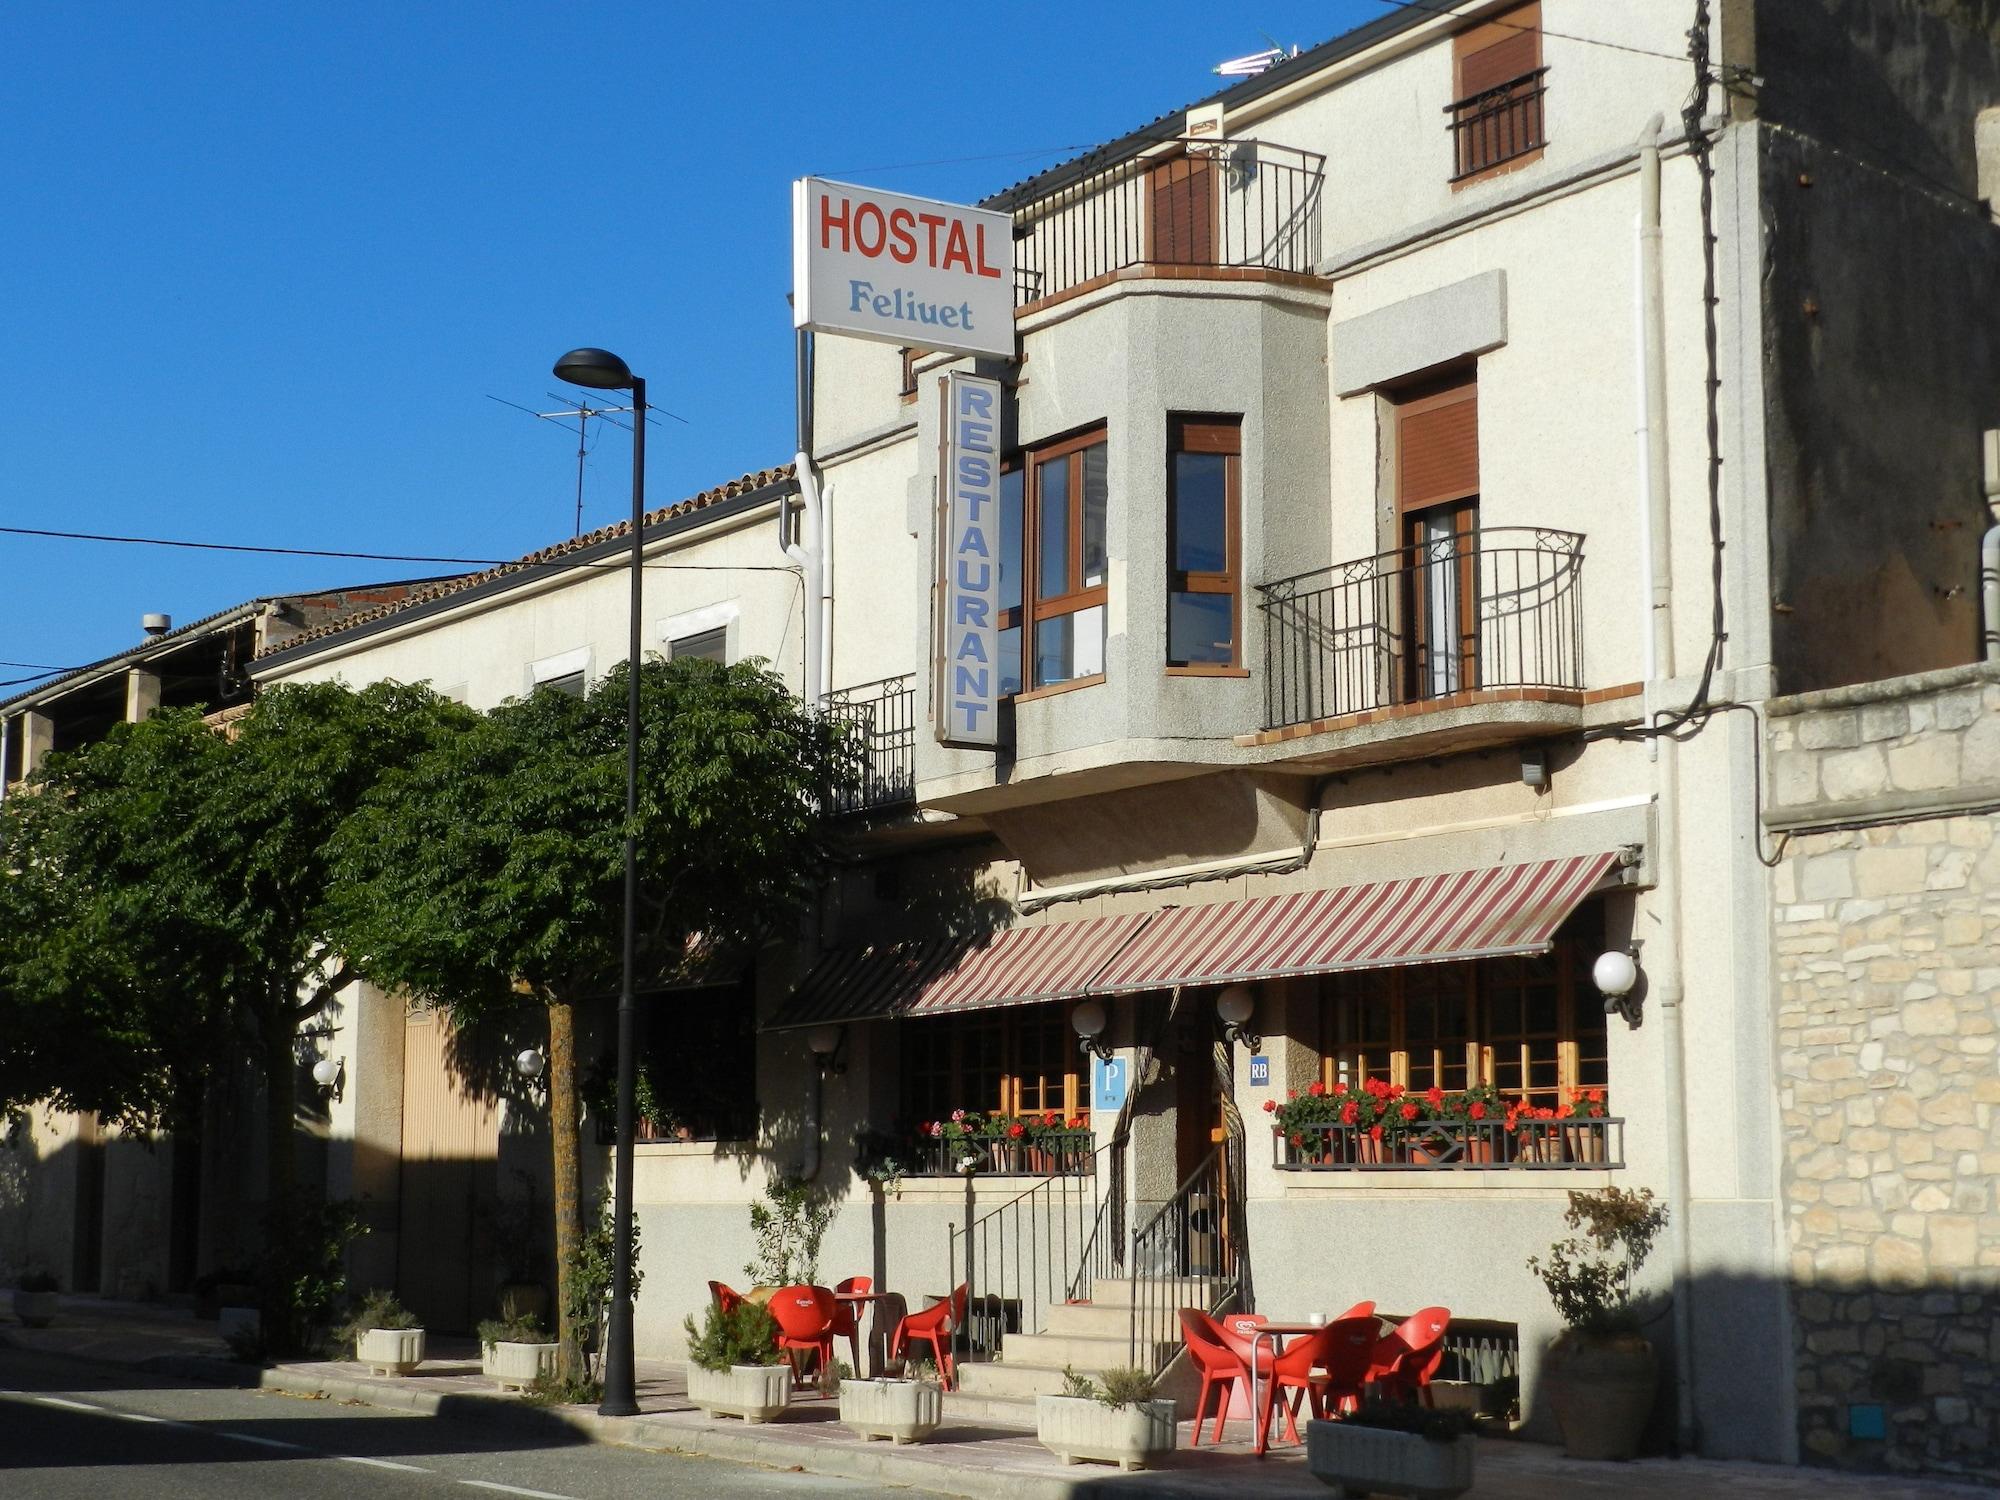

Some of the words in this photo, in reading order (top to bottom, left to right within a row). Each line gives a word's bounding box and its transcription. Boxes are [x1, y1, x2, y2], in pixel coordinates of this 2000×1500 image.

[821, 195, 1001, 279] HOSTAL
[849, 279, 975, 331] Feliuet
[954, 386, 994, 733] RESTAURANT
[1104, 1063, 1119, 1091] P
[1251, 1063, 1268, 1079] RB
